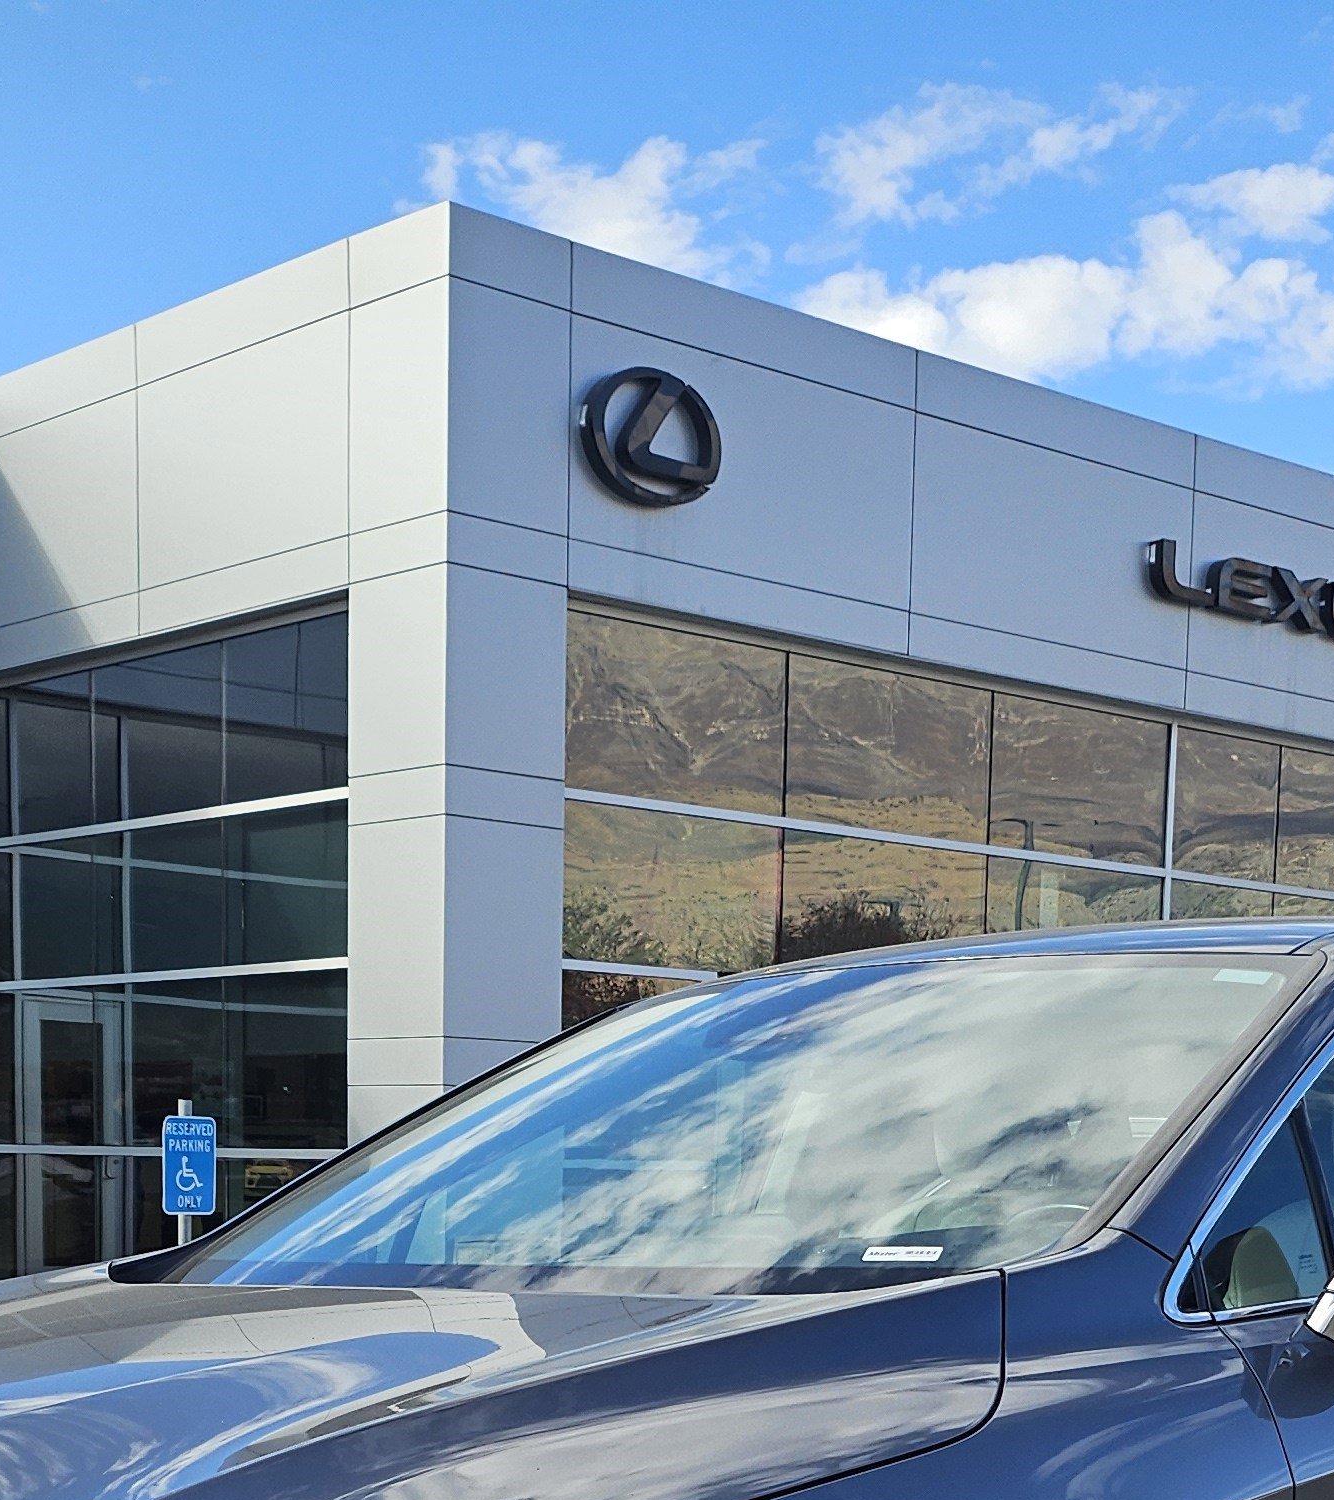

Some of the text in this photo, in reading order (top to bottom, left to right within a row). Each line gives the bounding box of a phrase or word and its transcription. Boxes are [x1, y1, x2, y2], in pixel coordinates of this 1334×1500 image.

[166, 1123, 214, 1136] RESERVED
[169, 1139, 211, 1152] PARKING
[178, 1195, 203, 1208] ONLY
